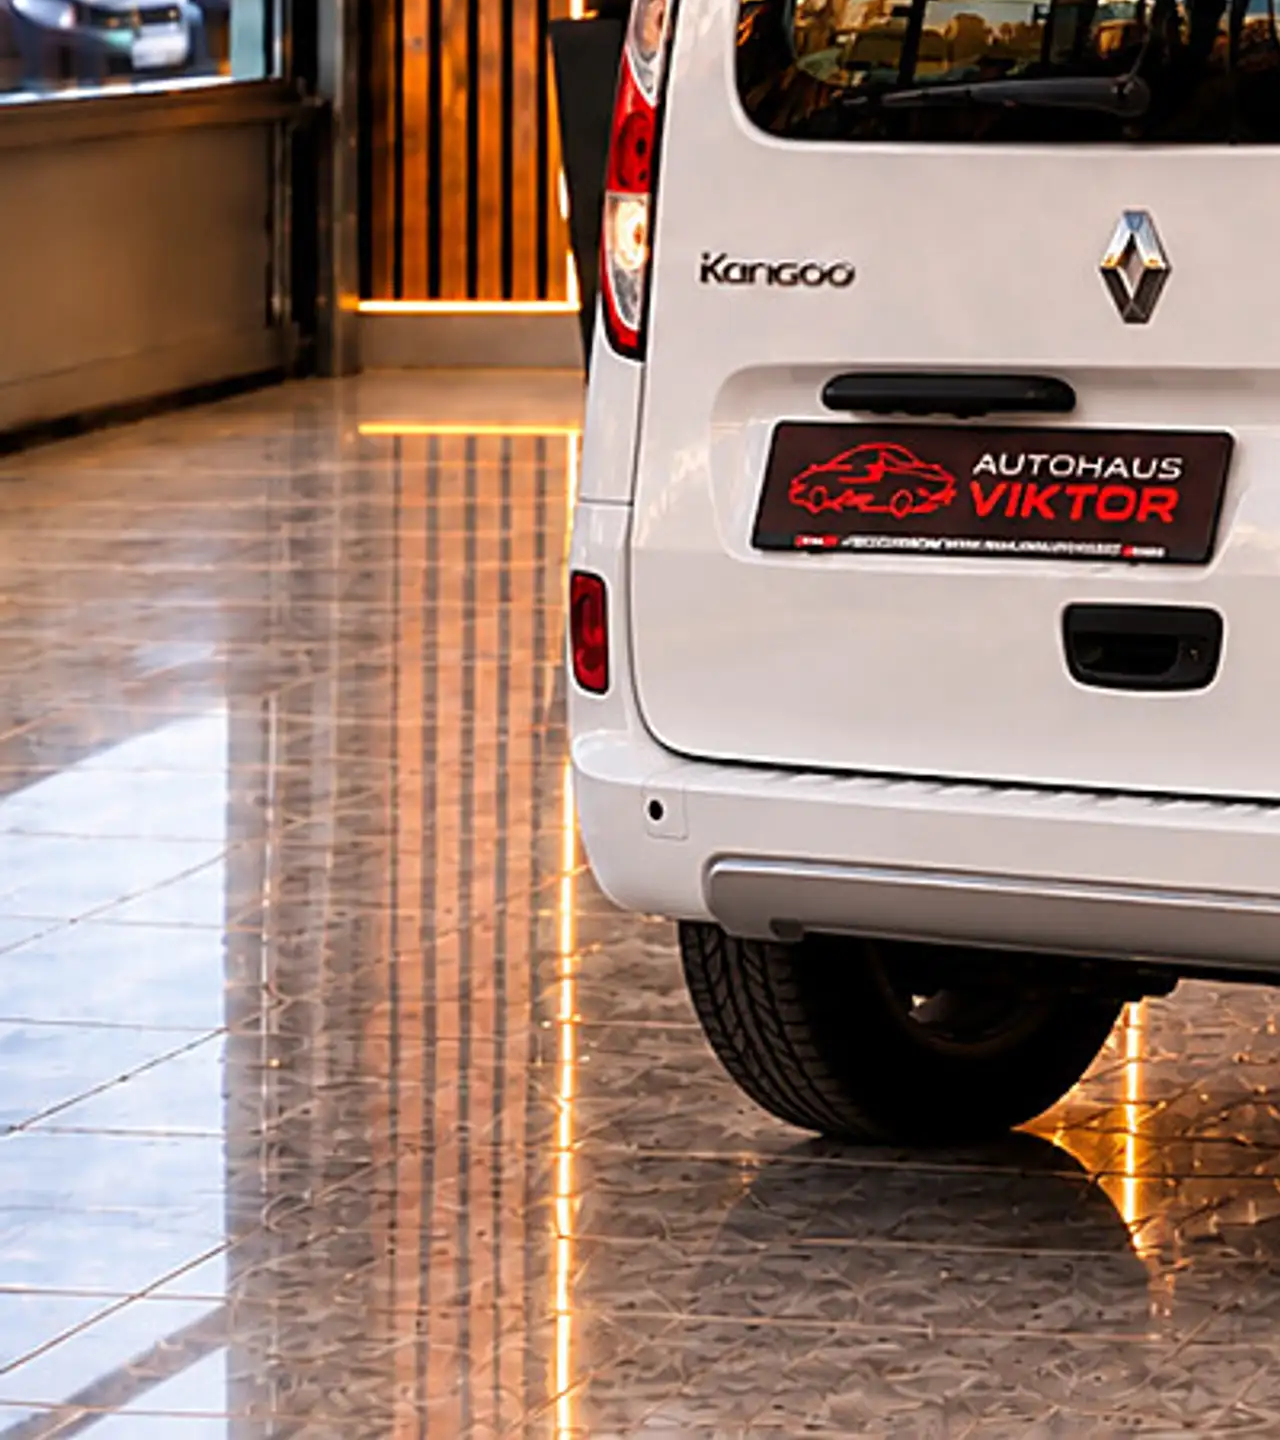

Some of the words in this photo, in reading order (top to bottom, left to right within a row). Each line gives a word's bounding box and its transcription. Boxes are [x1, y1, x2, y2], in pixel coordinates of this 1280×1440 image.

[700, 251, 856, 289] Kangoo
[972, 453, 1183, 479] AUTOHAUS
[970, 482, 1180, 523] VIKTOR
